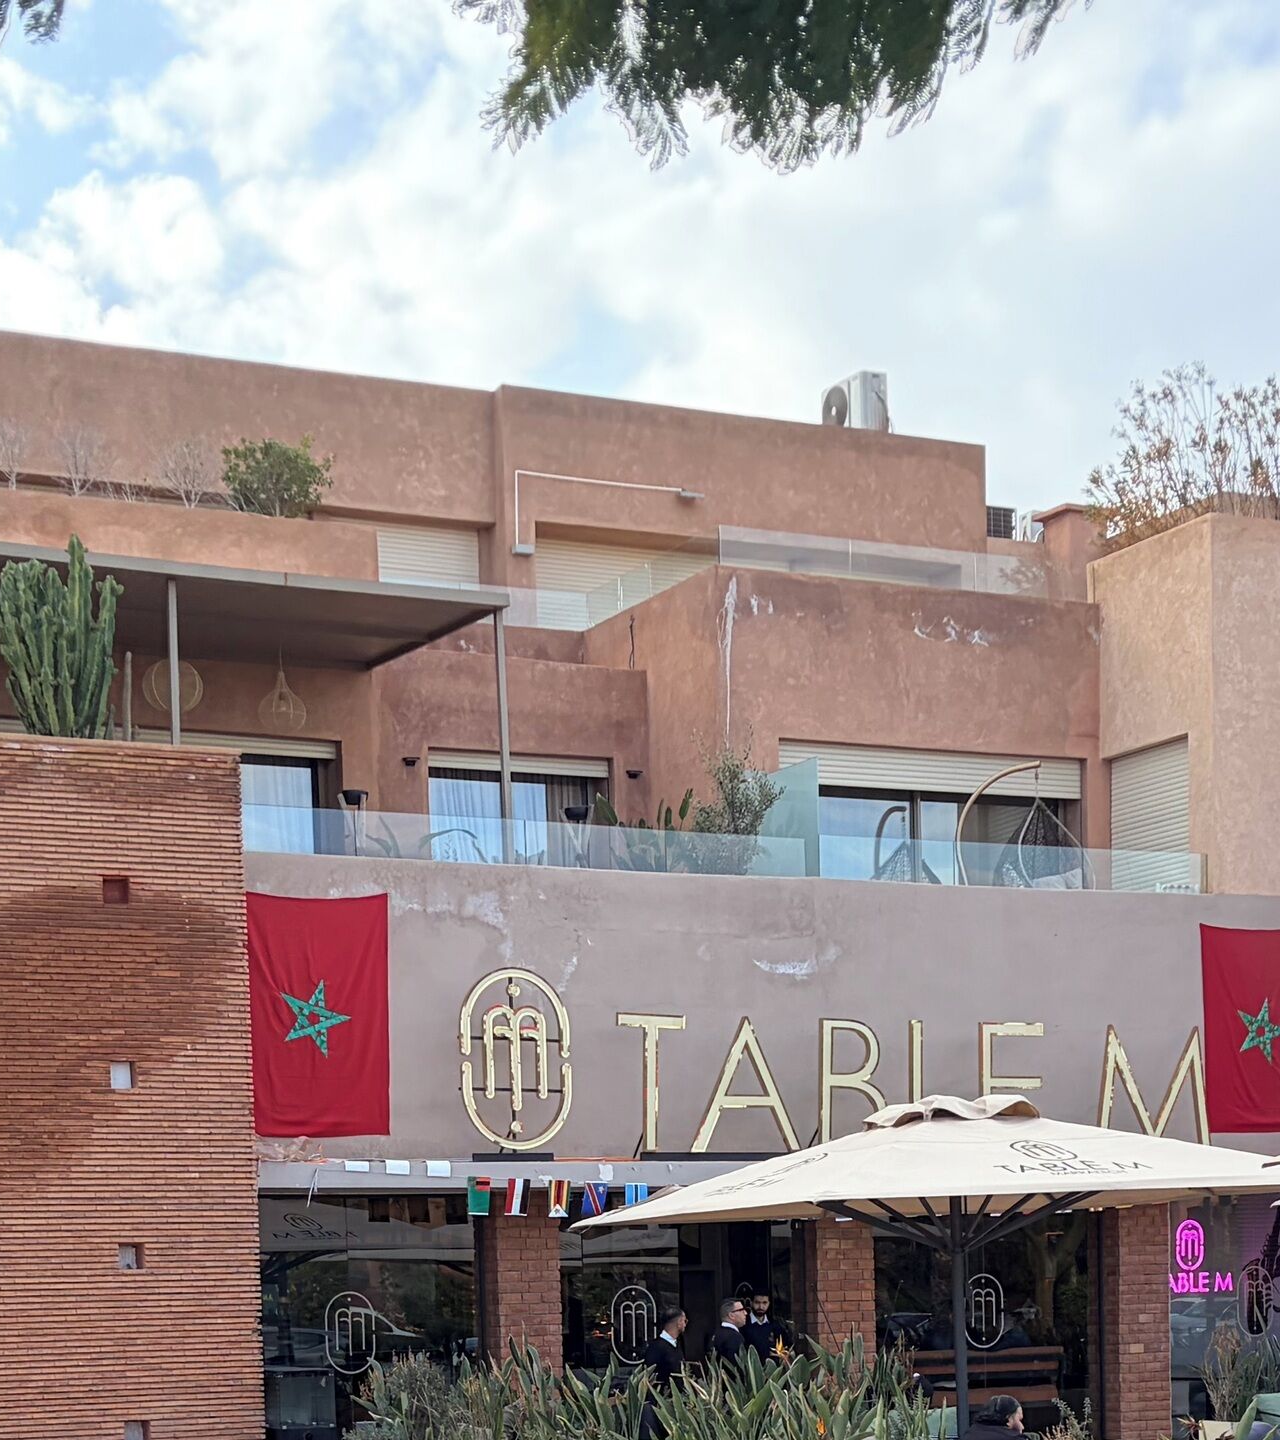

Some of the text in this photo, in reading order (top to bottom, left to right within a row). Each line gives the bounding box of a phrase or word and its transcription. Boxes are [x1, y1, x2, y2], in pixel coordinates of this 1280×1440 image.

[1098, 1023, 1210, 1146] M
[993, 1160, 1108, 1173] TABLE
[1112, 1161, 1152, 1169] M
[1214, 1272, 1233, 1292] M
